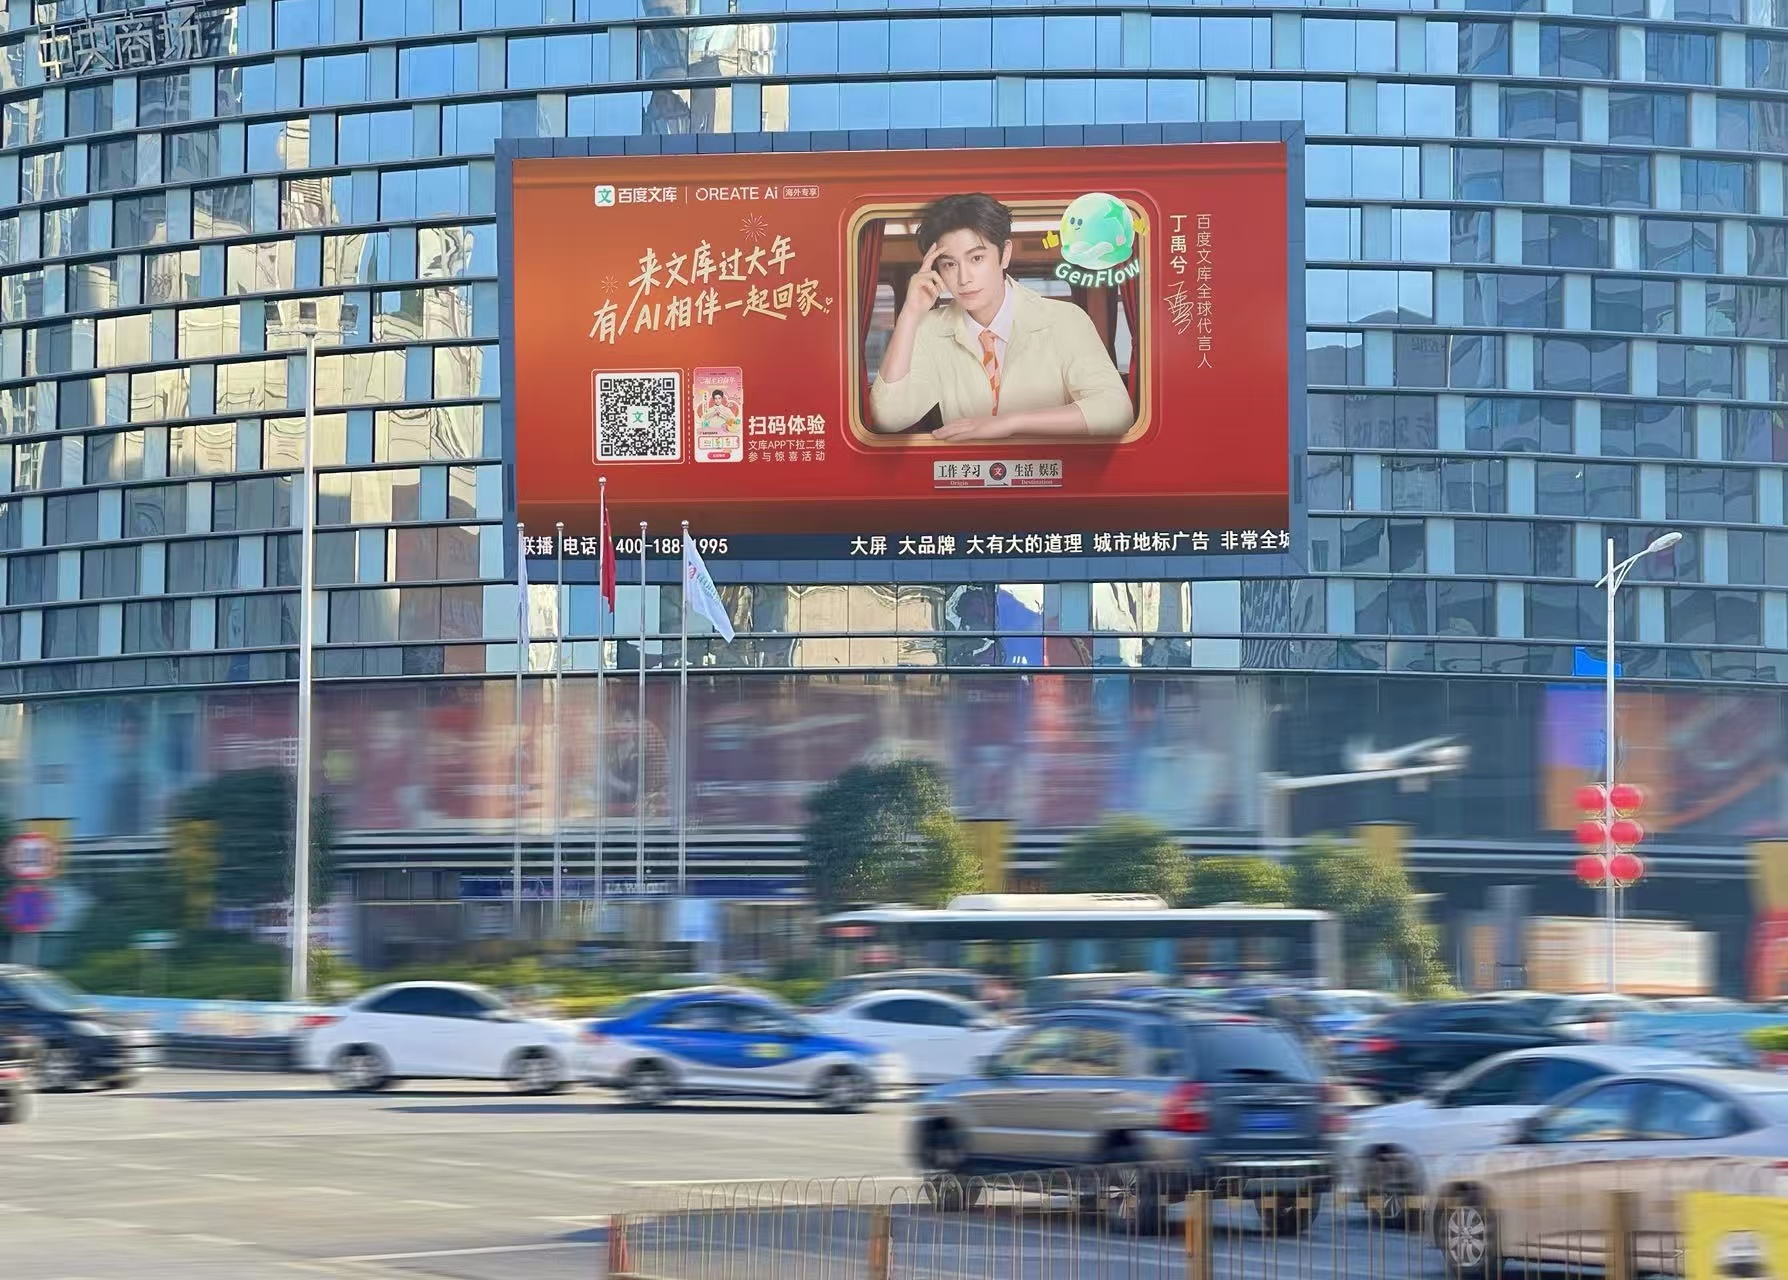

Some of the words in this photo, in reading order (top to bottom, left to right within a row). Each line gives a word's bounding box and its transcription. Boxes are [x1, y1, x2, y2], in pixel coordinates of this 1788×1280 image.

[618, 186, 677, 203] 百度文库
[764, 186, 778, 200] Ai
[1169, 214, 1188, 275] 丁禹兮
[628, 234, 796, 296] 来文库过大年
[1055, 258, 1140, 288] GenFlow
[1196, 213, 1213, 369] 百度文库全球代言人
[748, 414, 826, 436] 扫码体验
[748, 439, 826, 451] 文库APP下拉二楼
[748, 451, 826, 462] 参与惊喜活动
[938, 464, 958, 478] 工作
[961, 464, 981, 478] 学习
[1014, 463, 1034, 477] 生活
[1039, 462, 1059, 477] 娱乐
[563, 536, 597, 555] 电话
[615, 538, 728, 554] 400-188-995
[850, 536, 887, 555] 大屏
[898, 535, 956, 555] 大品牌
[966, 533, 1083, 554] 大有大的道理
[1093, 531, 1210, 552] 城市地标广告
